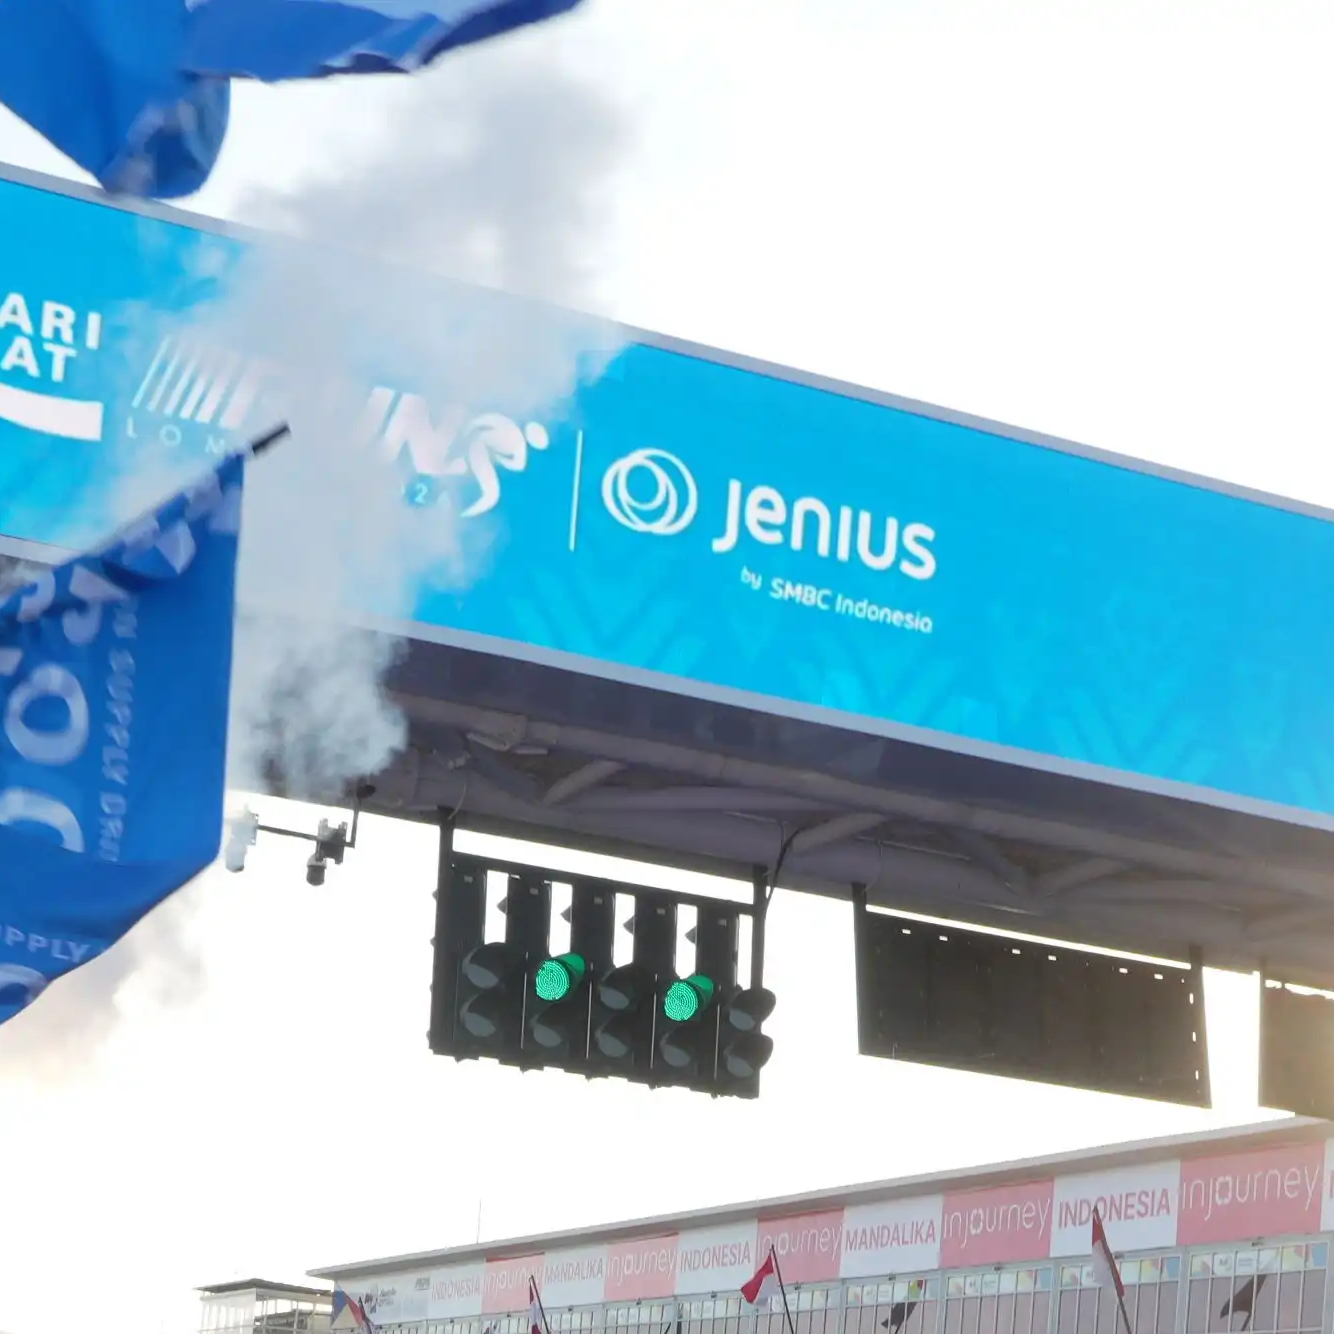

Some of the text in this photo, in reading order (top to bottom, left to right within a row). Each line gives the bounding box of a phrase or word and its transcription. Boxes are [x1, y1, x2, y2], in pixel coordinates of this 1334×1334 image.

[740, 566, 934, 634] by SMBC Indonesia
[544, 1257, 604, 1286] MANDALIKA
[606, 1237, 677, 1289] injourney
[680, 1240, 752, 1275] INDONESIA
[845, 1217, 937, 1253] MANDALIKA
[942, 1196, 1052, 1250] injourney
[1058, 1187, 1171, 1230] INDONESIA
[1181, 1160, 1324, 1222] injourney
